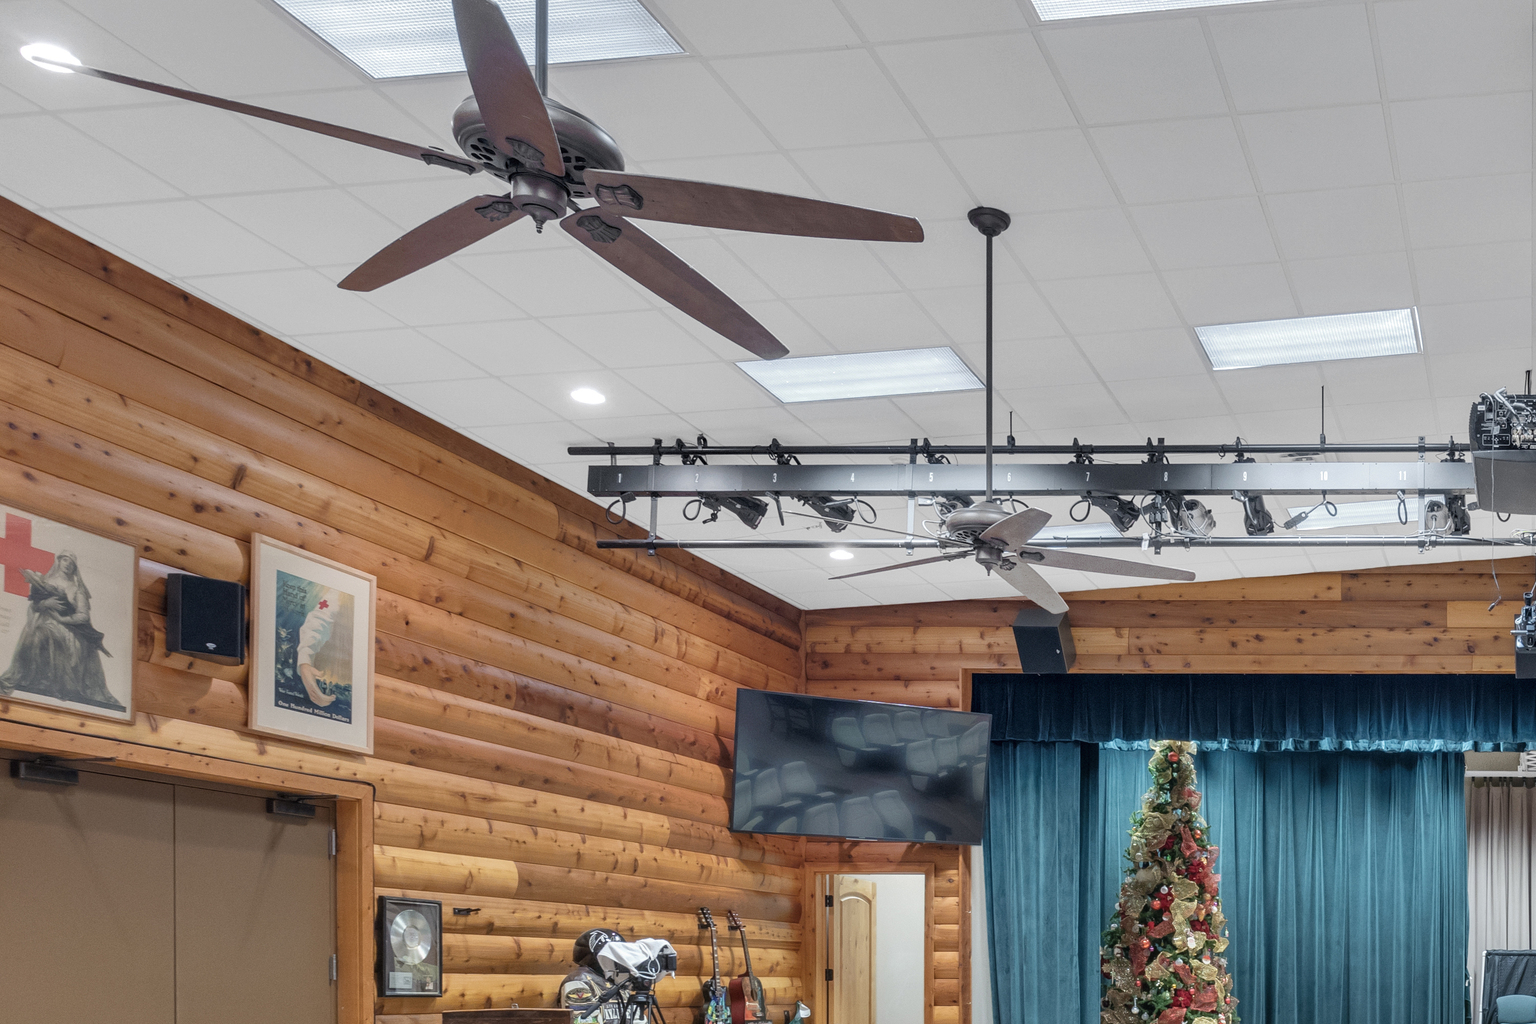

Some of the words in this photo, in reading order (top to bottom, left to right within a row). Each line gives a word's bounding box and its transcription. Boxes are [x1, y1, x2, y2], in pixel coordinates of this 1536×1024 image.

[618, 474, 622, 484] 1
[694, 474, 700, 483] 2
[772, 473, 778, 483] 3
[850, 473, 855, 483] 4
[928, 473, 934, 483] 5
[1006, 473, 1012, 482] 6
[1085, 472, 1091, 482] 7
[1163, 472, 1169, 482] 8
[1242, 472, 1248, 482] 9
[1320, 471, 1329, 481] 10
[1398, 471, 1407, 481] 11
[290, 703, 313, 713] Hundred
[314, 709, 331, 718] Million
[332, 713, 350, 722] Dollars
